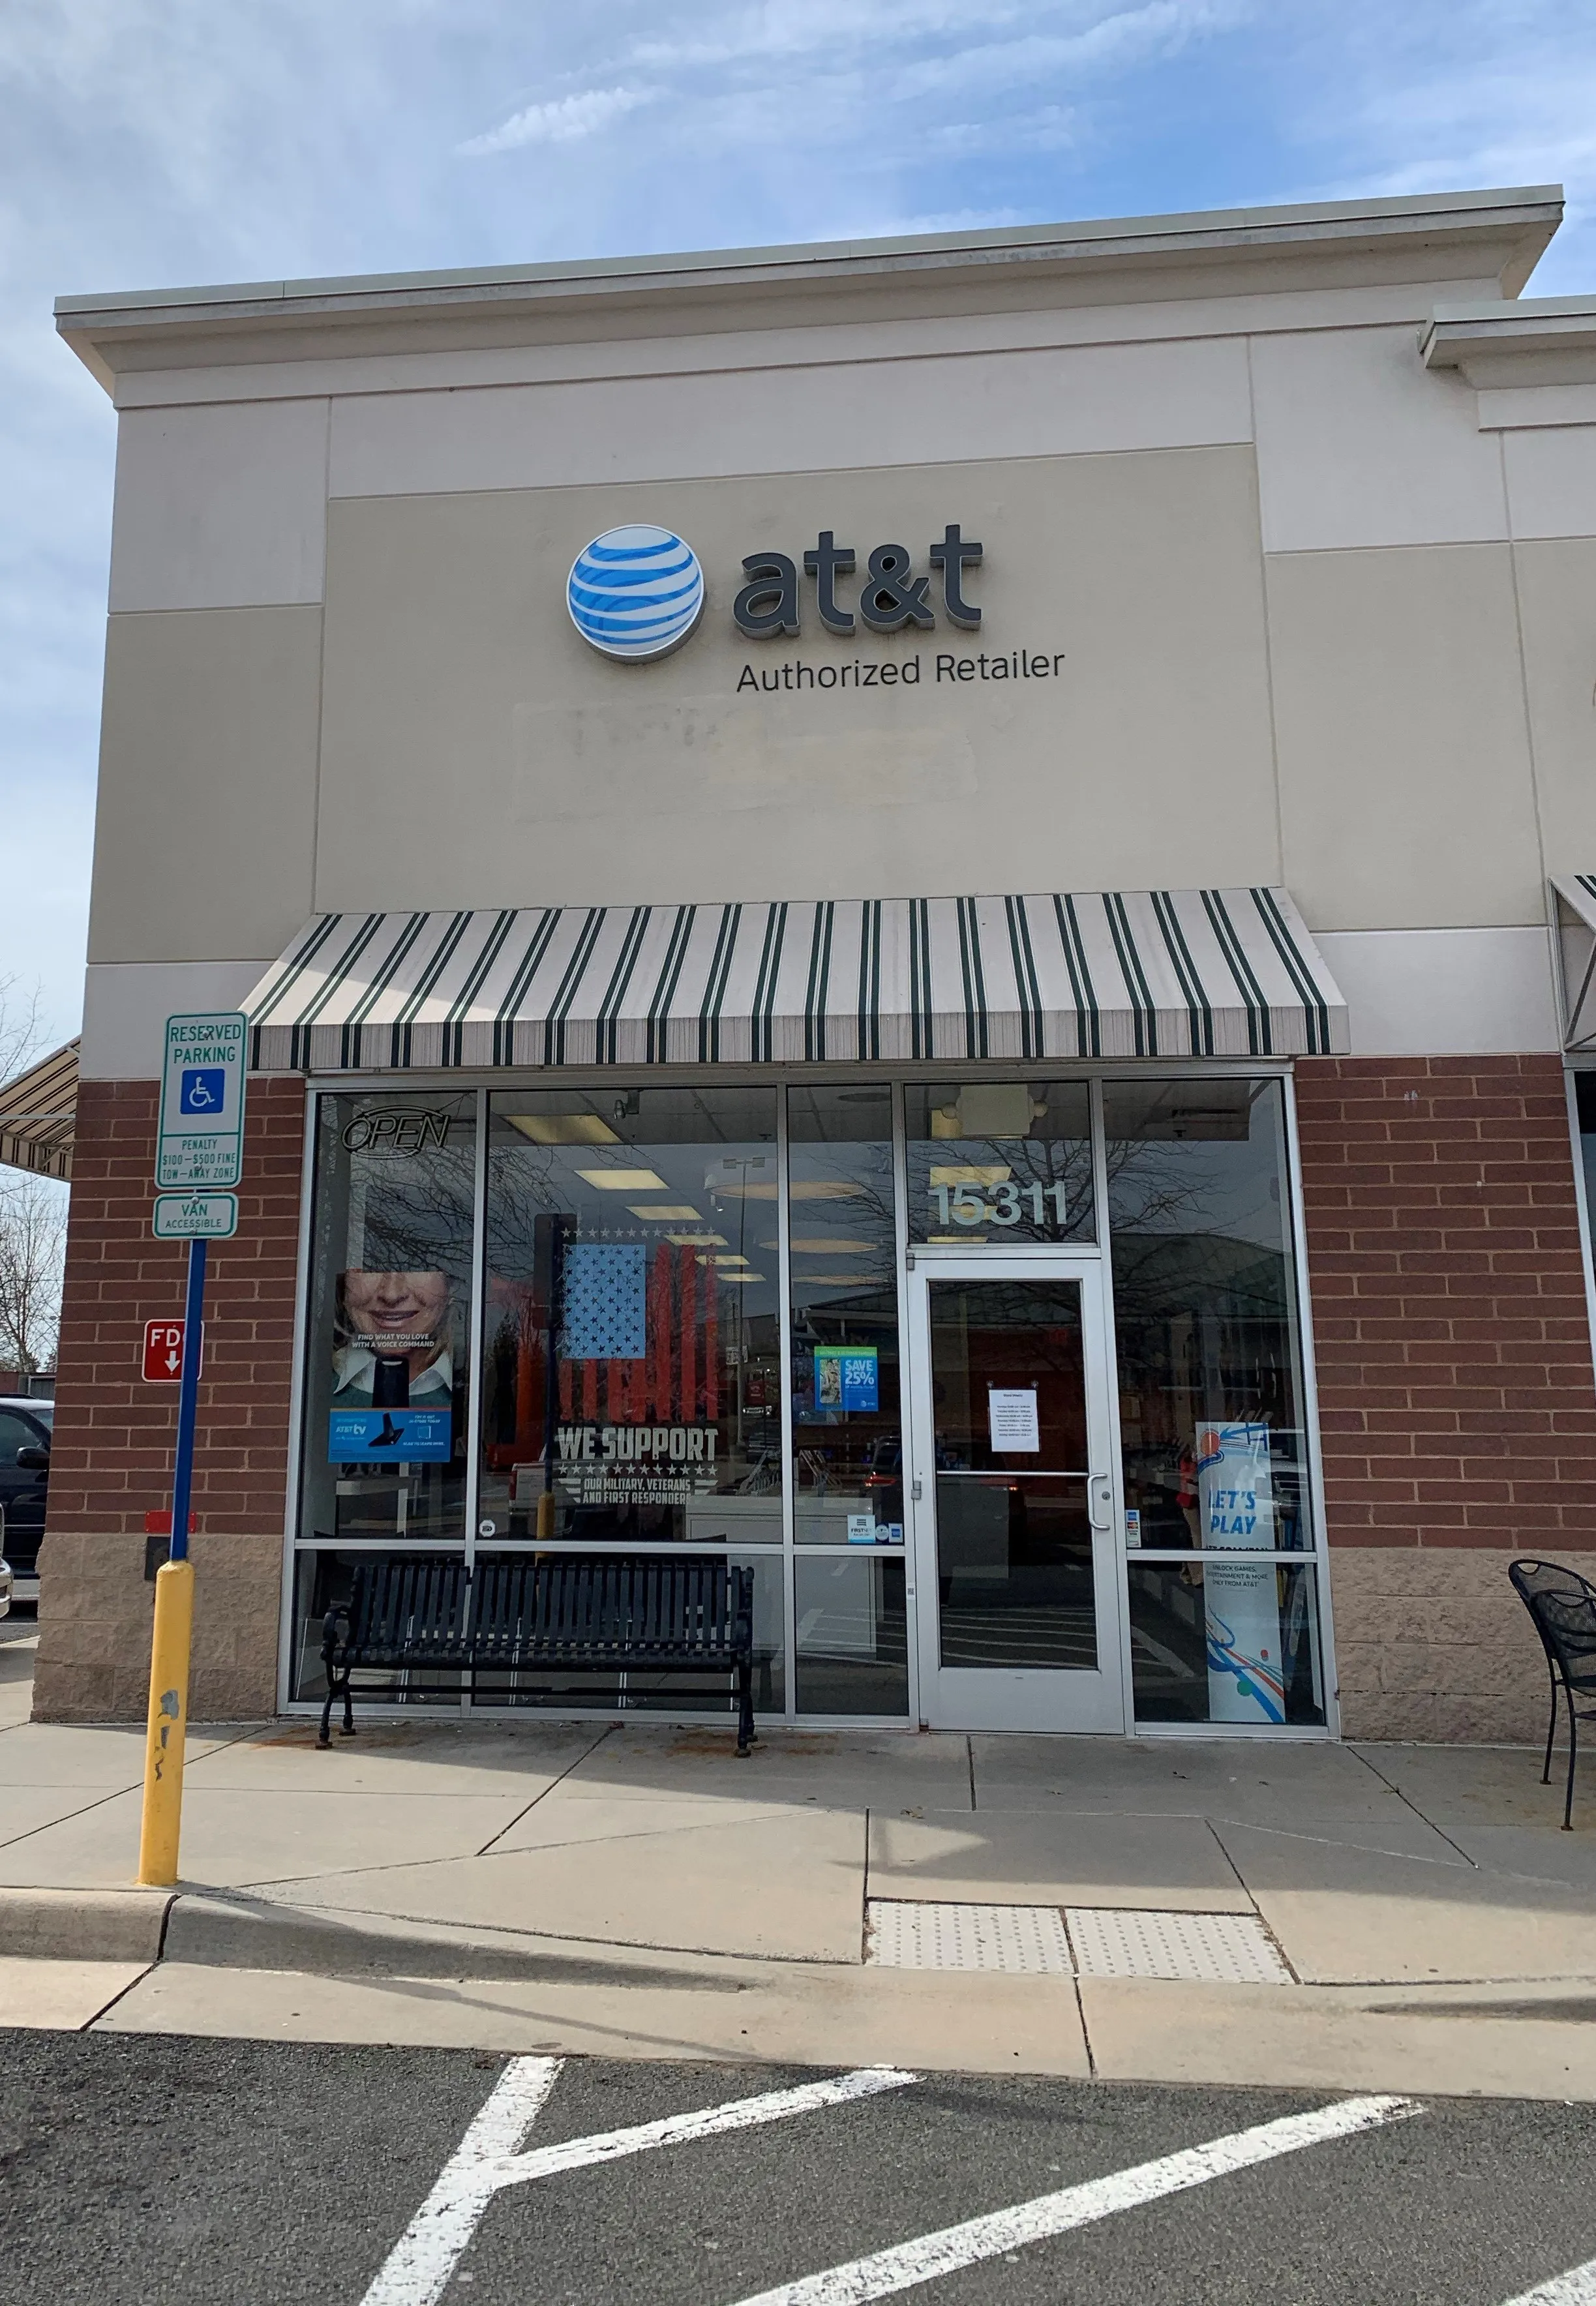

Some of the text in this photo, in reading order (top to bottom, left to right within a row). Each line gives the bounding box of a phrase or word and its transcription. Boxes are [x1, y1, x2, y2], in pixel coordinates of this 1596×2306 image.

[733, 524, 982, 639] at&t
[736, 650, 1065, 693] Authorized Retailer
[170, 1024, 241, 1043] RESERVED
[173, 1046, 236, 1064] PARKING
[341, 1115, 451, 1152] OPEN
[181, 1139, 218, 1150] PENALTY
[217, 1152, 235, 1163] FINE
[213, 1167, 234, 1178] ZONE
[181, 1203, 208, 1217] VAN
[927, 1181, 1067, 1226] 15311
[165, 1218, 222, 1229] ACCESSIBLE
[151, 1328, 185, 1347] FD
[845, 1360, 873, 1371] SAVE
[845, 1371, 875, 1385] 25%
[558, 1427, 719, 1461] WE SUPPORT
[584, 1478, 691, 1491] OUR MILITARY, VETERANS
[583, 1492, 603, 1504] AND
[604, 1492, 629, 1504] FIRST
[1208, 1490, 1256, 1510] LET'S
[1211, 1515, 1256, 1535] PLAY
